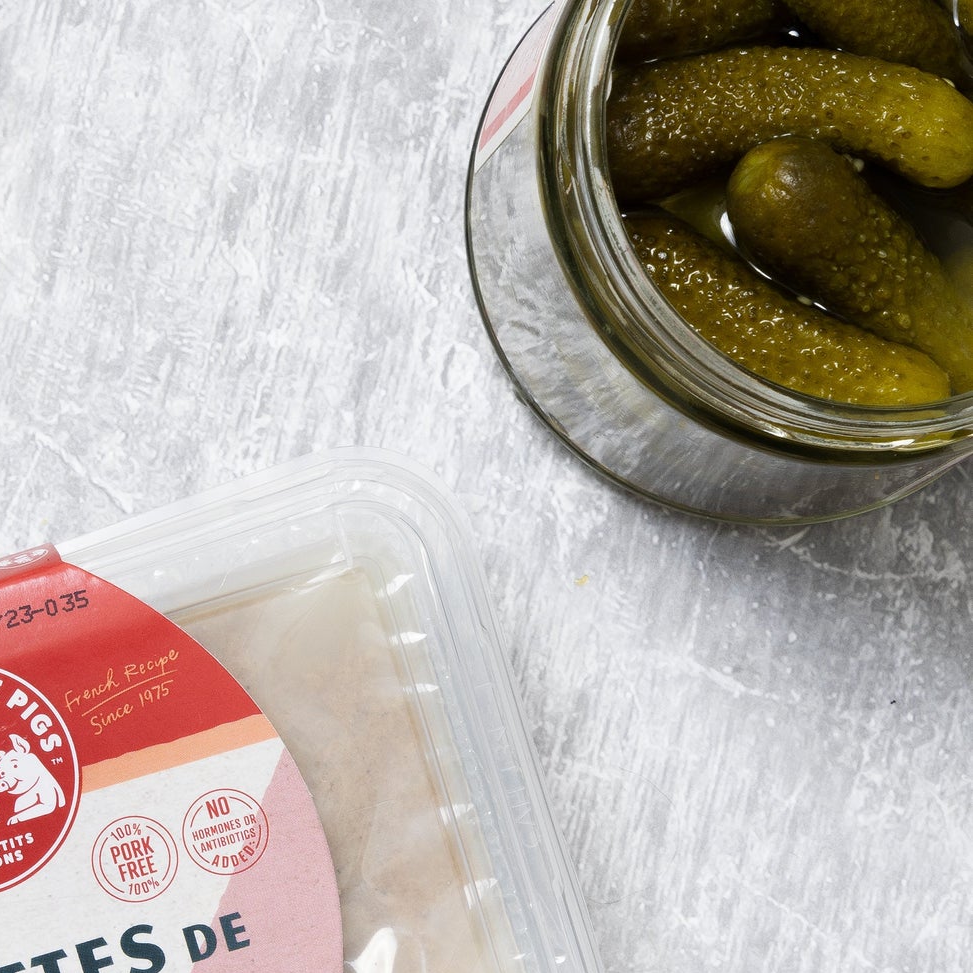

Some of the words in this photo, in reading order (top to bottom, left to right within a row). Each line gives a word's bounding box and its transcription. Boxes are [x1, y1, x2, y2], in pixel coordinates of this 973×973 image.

[64, 667, 120, 713] French
[124, 648, 179, 683] Recipe
[5, 687, 64, 753] PIGS
[90, 703, 134, 736] Since
[139, 680, 174, 708] 1975
[205, 795, 231, 820] NO
[110, 822, 143, 842] 100%
[191, 818, 242, 842] HORMONES
[243, 813, 258, 826] OR
[199, 827, 257, 853] ANTIBIOTICS
[109, 835, 155, 865] PORK
[117, 855, 158, 883] FREE
[128, 876, 160, 896] 100%
[181, 911, 252, 963] DE
